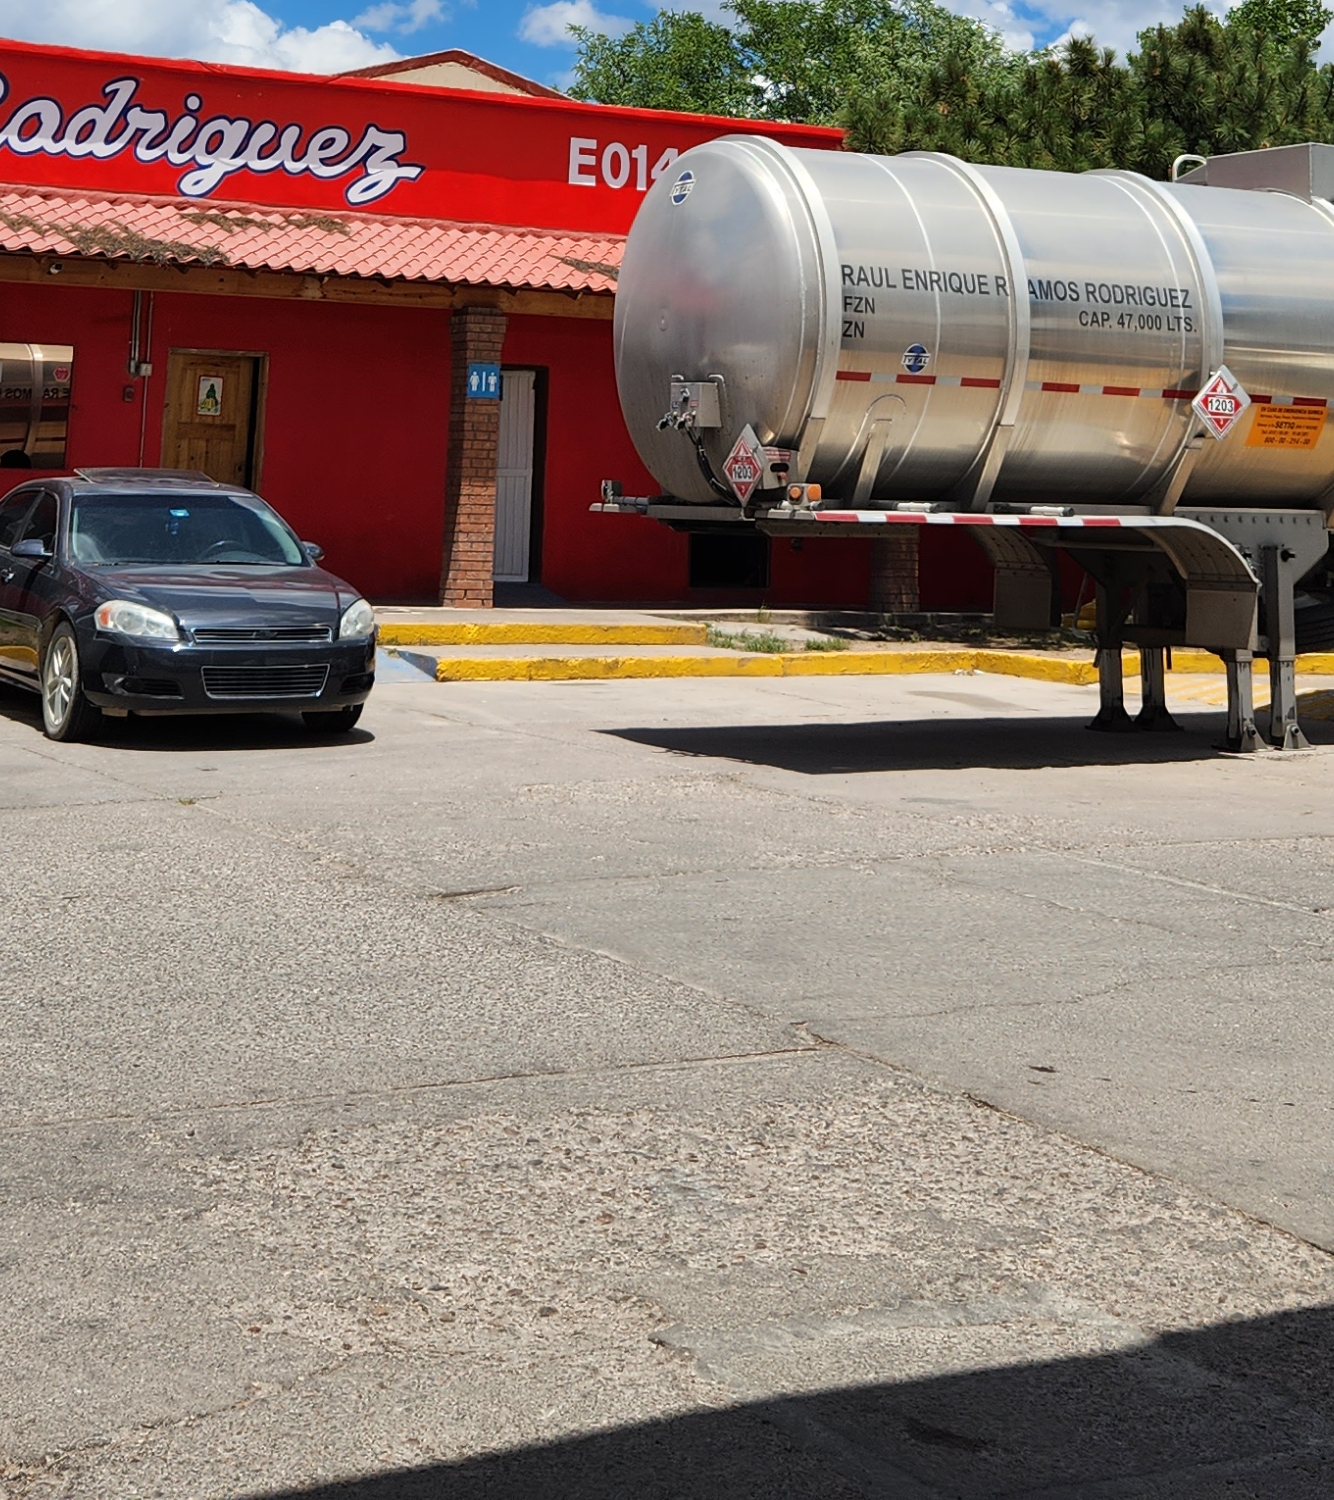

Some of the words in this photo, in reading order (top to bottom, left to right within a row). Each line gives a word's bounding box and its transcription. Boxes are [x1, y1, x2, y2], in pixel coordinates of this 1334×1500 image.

[841, 264, 896, 288] RAUL
[901, 268, 990, 295] ENRIQUE
[1085, 282, 1192, 308] RODRIGUEZ
[843, 296, 875, 314] FZN
[842, 321, 865, 338] ZN
[1079, 310, 1112, 329] CAP.
[1117, 312, 1162, 332] 47,000
[1167, 316, 1197, 332] LTS.
[1209, 398, 1234, 412] 1203
[733, 465, 753, 479] 1203
